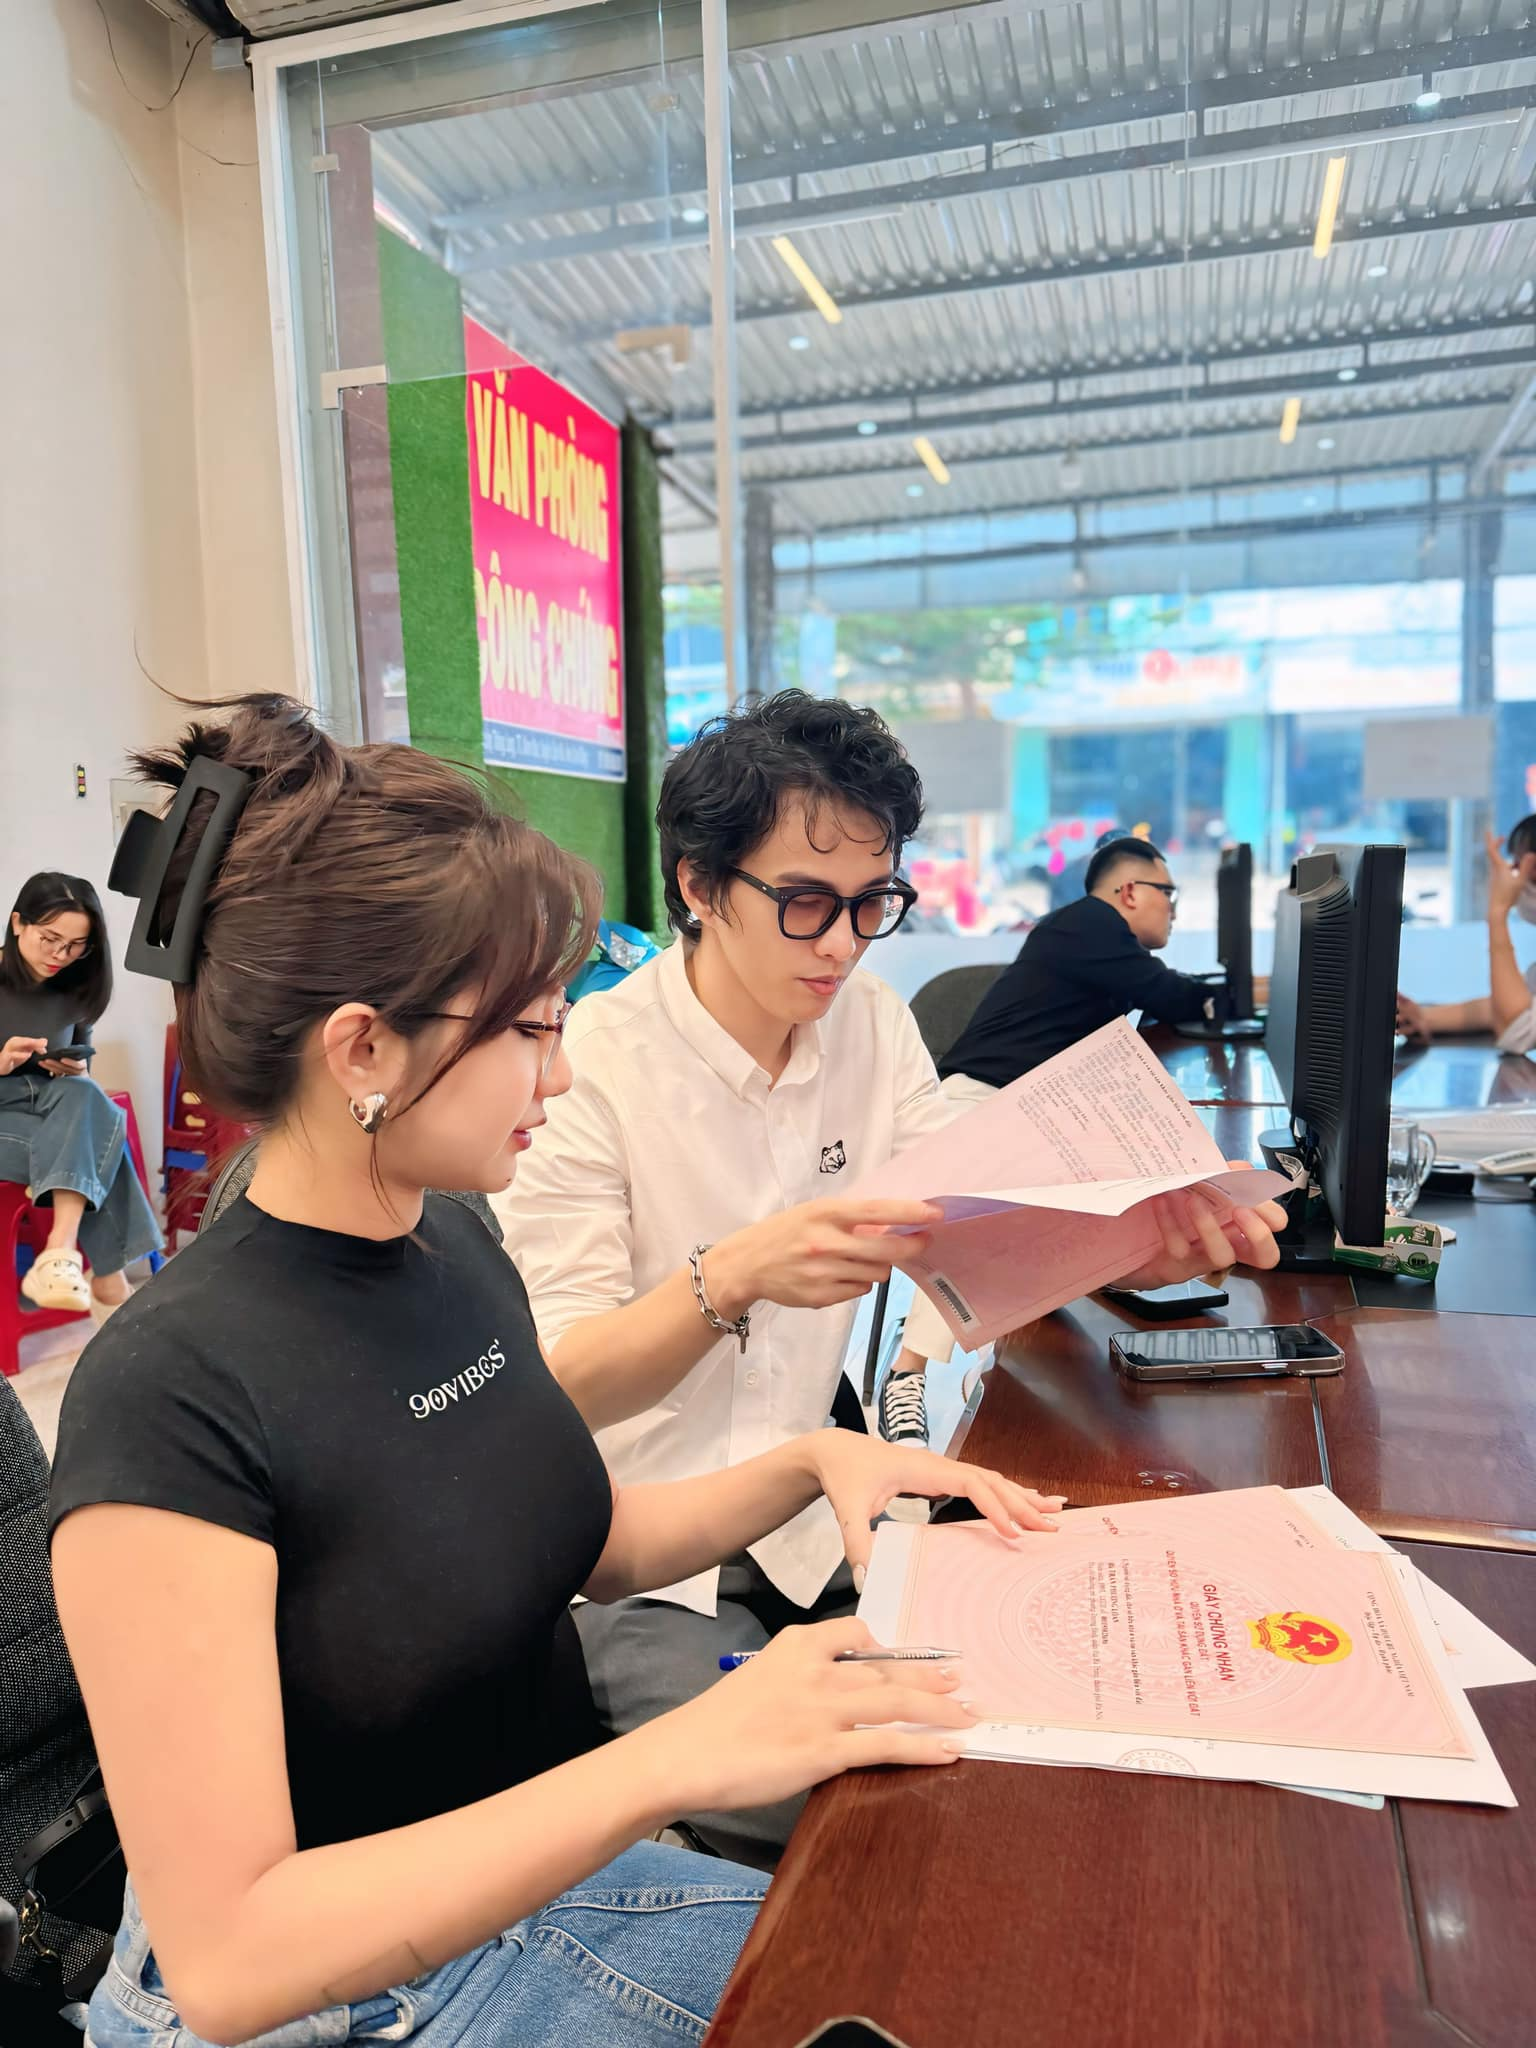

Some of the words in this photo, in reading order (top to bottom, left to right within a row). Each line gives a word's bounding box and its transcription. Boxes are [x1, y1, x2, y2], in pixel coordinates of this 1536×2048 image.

[472, 367, 529, 520] VĂN
[534, 416, 609, 562] PHÒNG
[546, 587, 618, 718] CHỨNG
